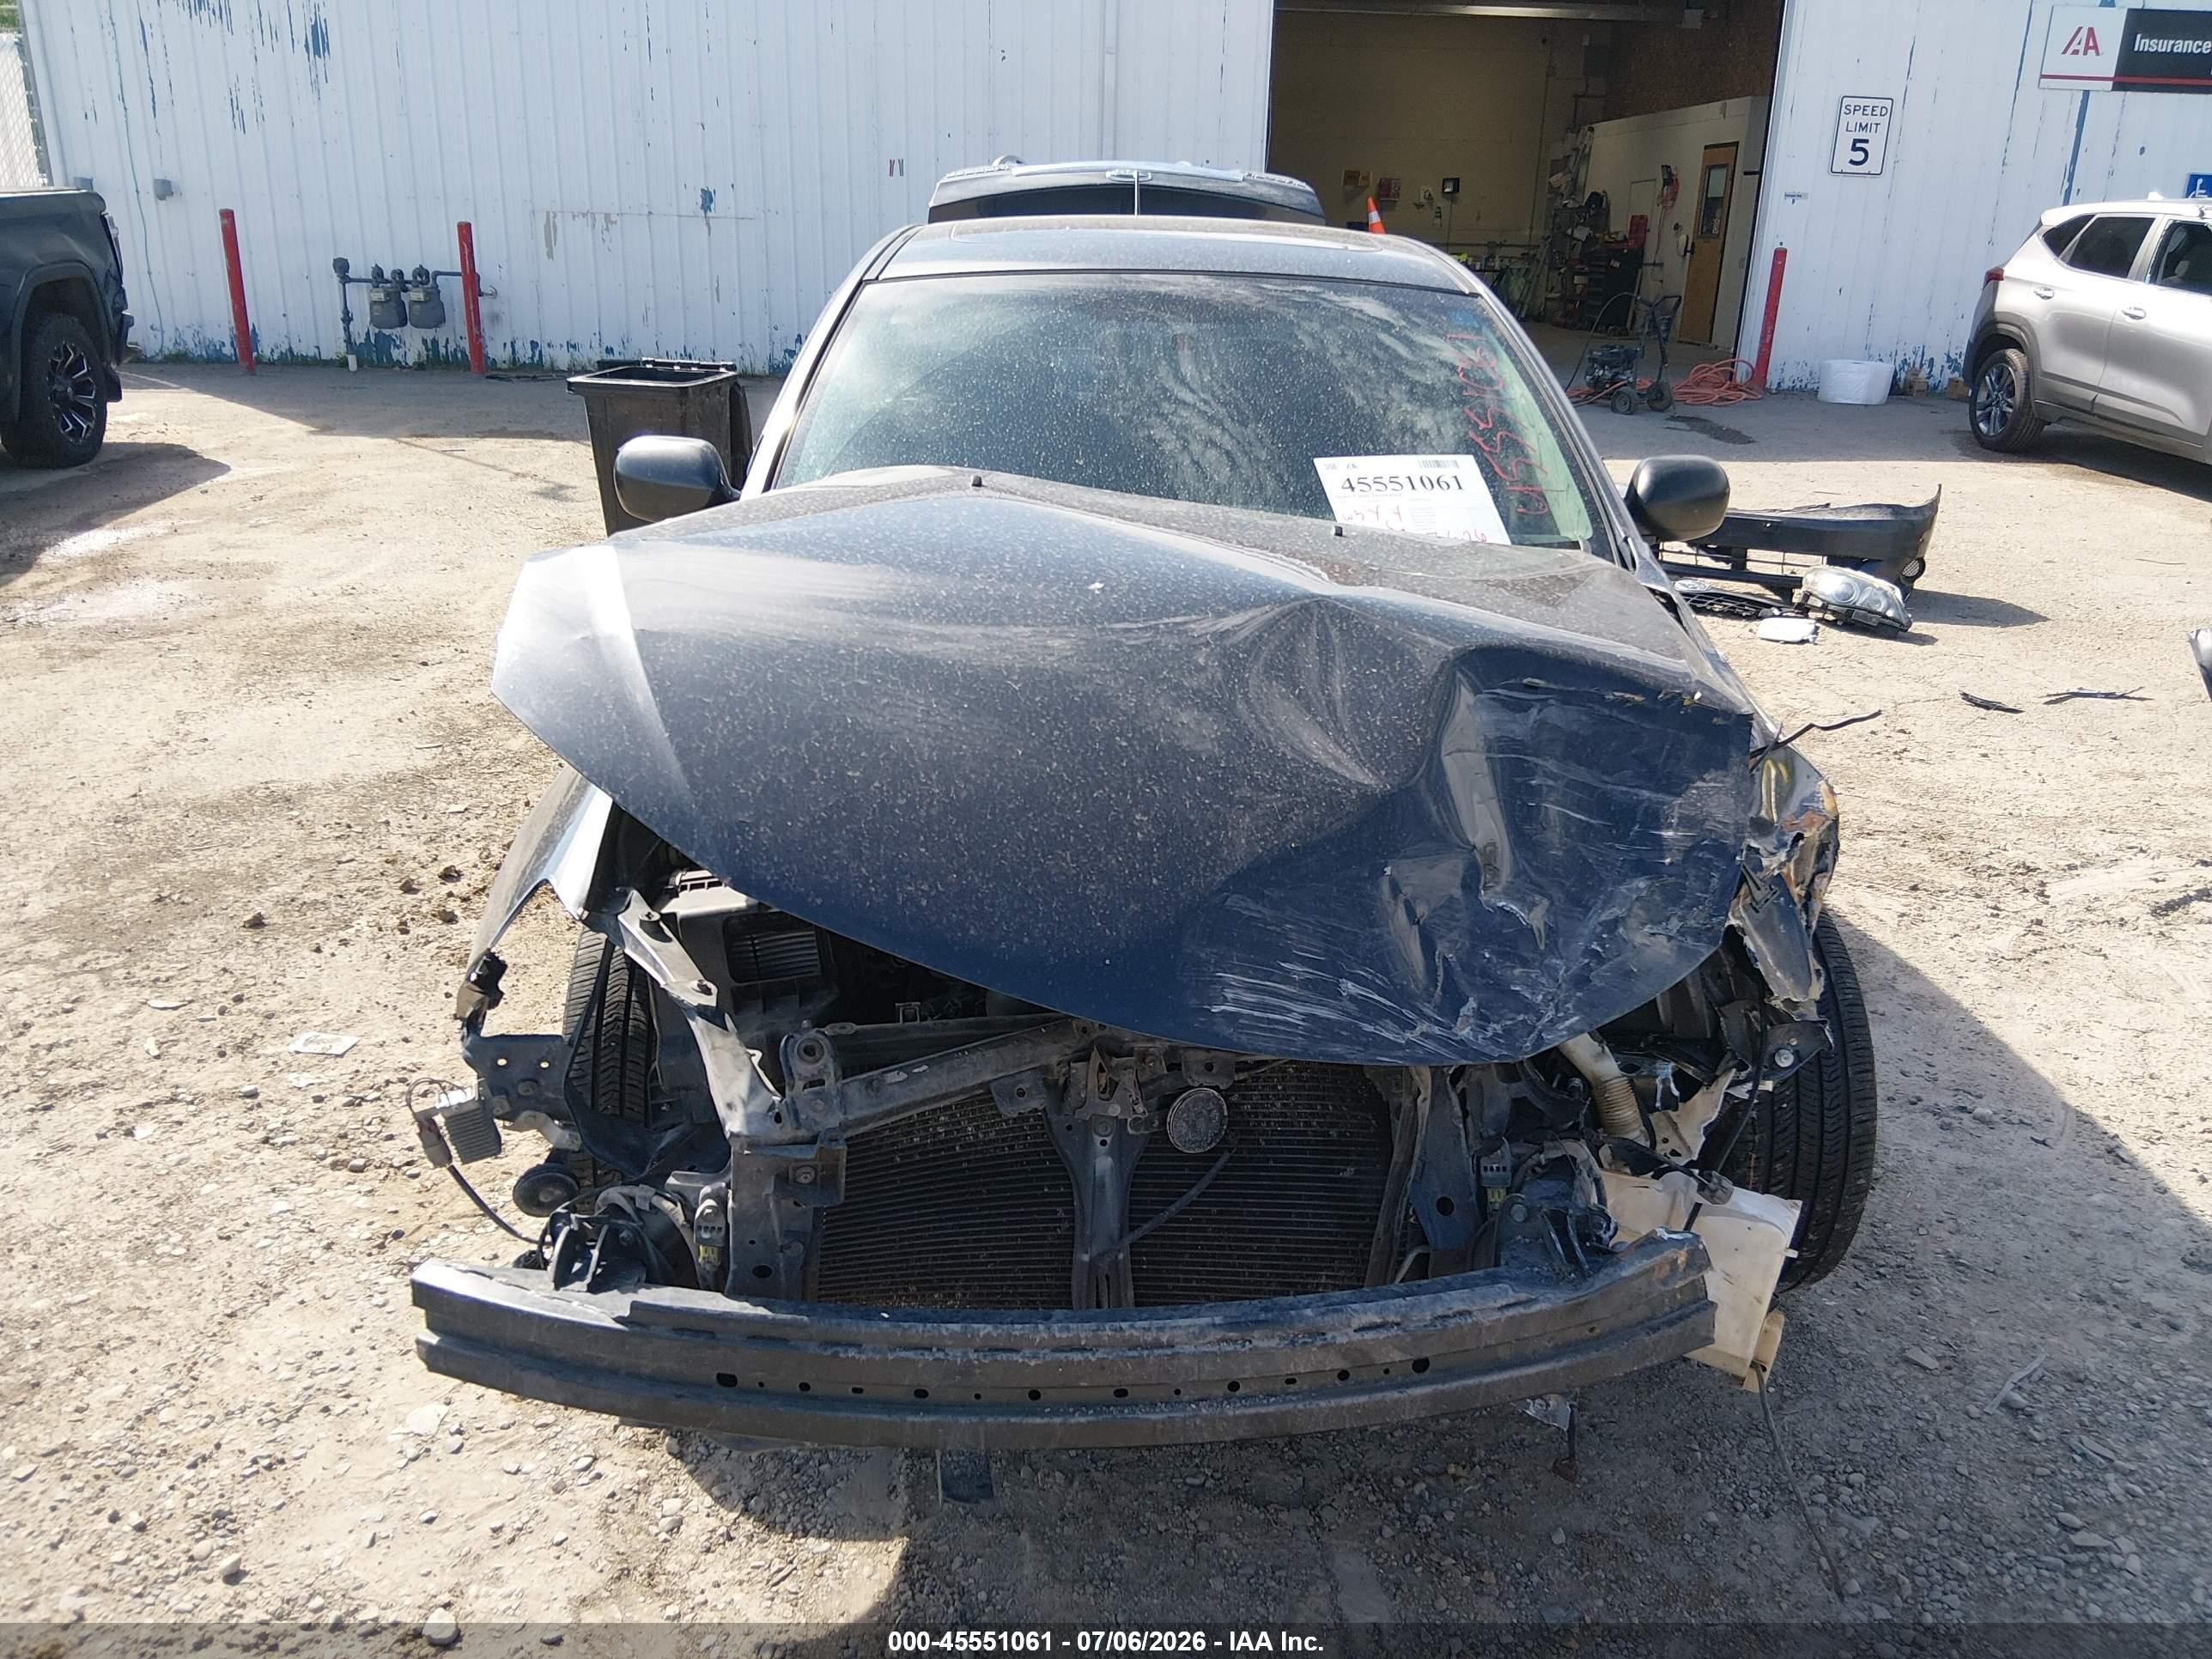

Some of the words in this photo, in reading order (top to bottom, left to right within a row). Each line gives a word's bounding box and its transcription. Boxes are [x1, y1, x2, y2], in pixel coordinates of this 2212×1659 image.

[2134, 33, 2212, 54] Insurance
[1844, 104, 1888, 117] SPEED
[1845, 121, 1881, 133] LIMIT
[1848, 138, 1869, 166] 5
[1341, 474, 1465, 493] 45551061
